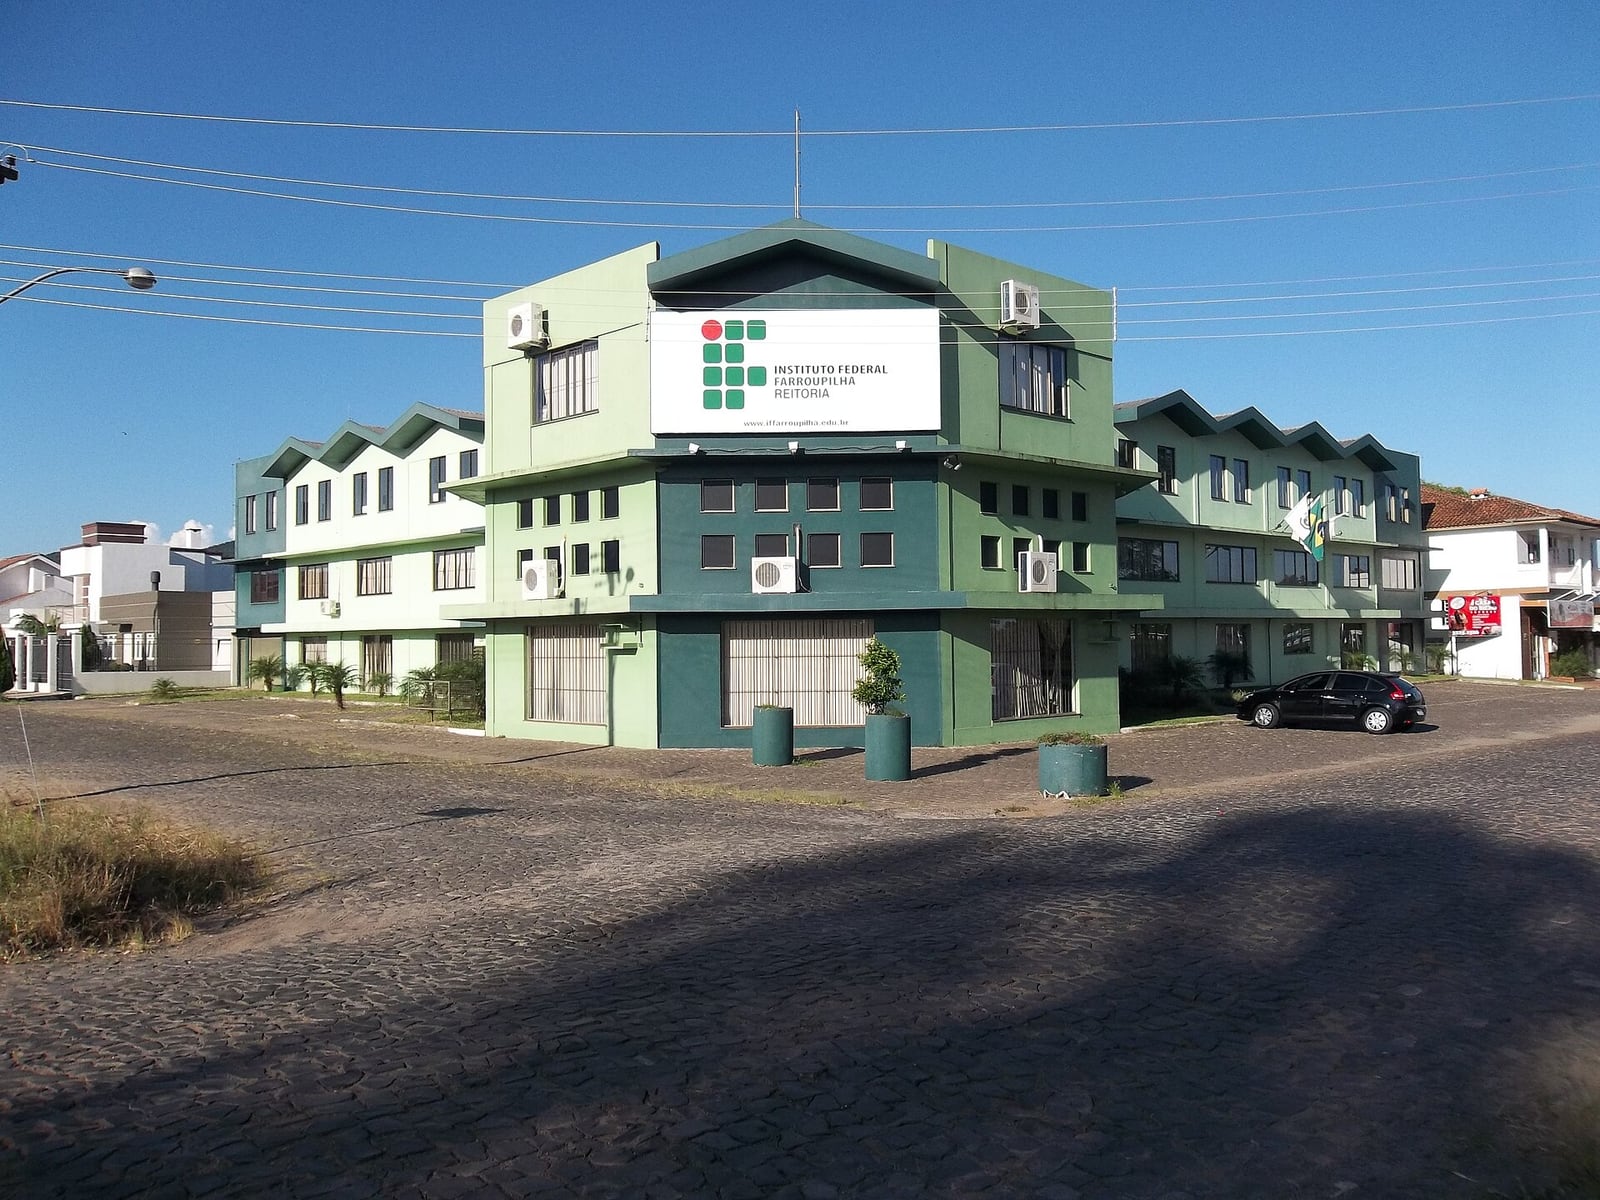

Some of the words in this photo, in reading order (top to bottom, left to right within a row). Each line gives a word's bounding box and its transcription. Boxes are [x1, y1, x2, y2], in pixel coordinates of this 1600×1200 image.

[774, 365, 835, 375] INSTITUTO
[838, 364, 889, 374] FEDERAL
[774, 376, 856, 386] FARROUPILHA
[774, 388, 830, 399] REITORIA
[743, 419, 849, 427] www.iffarroupilha.edu.br
